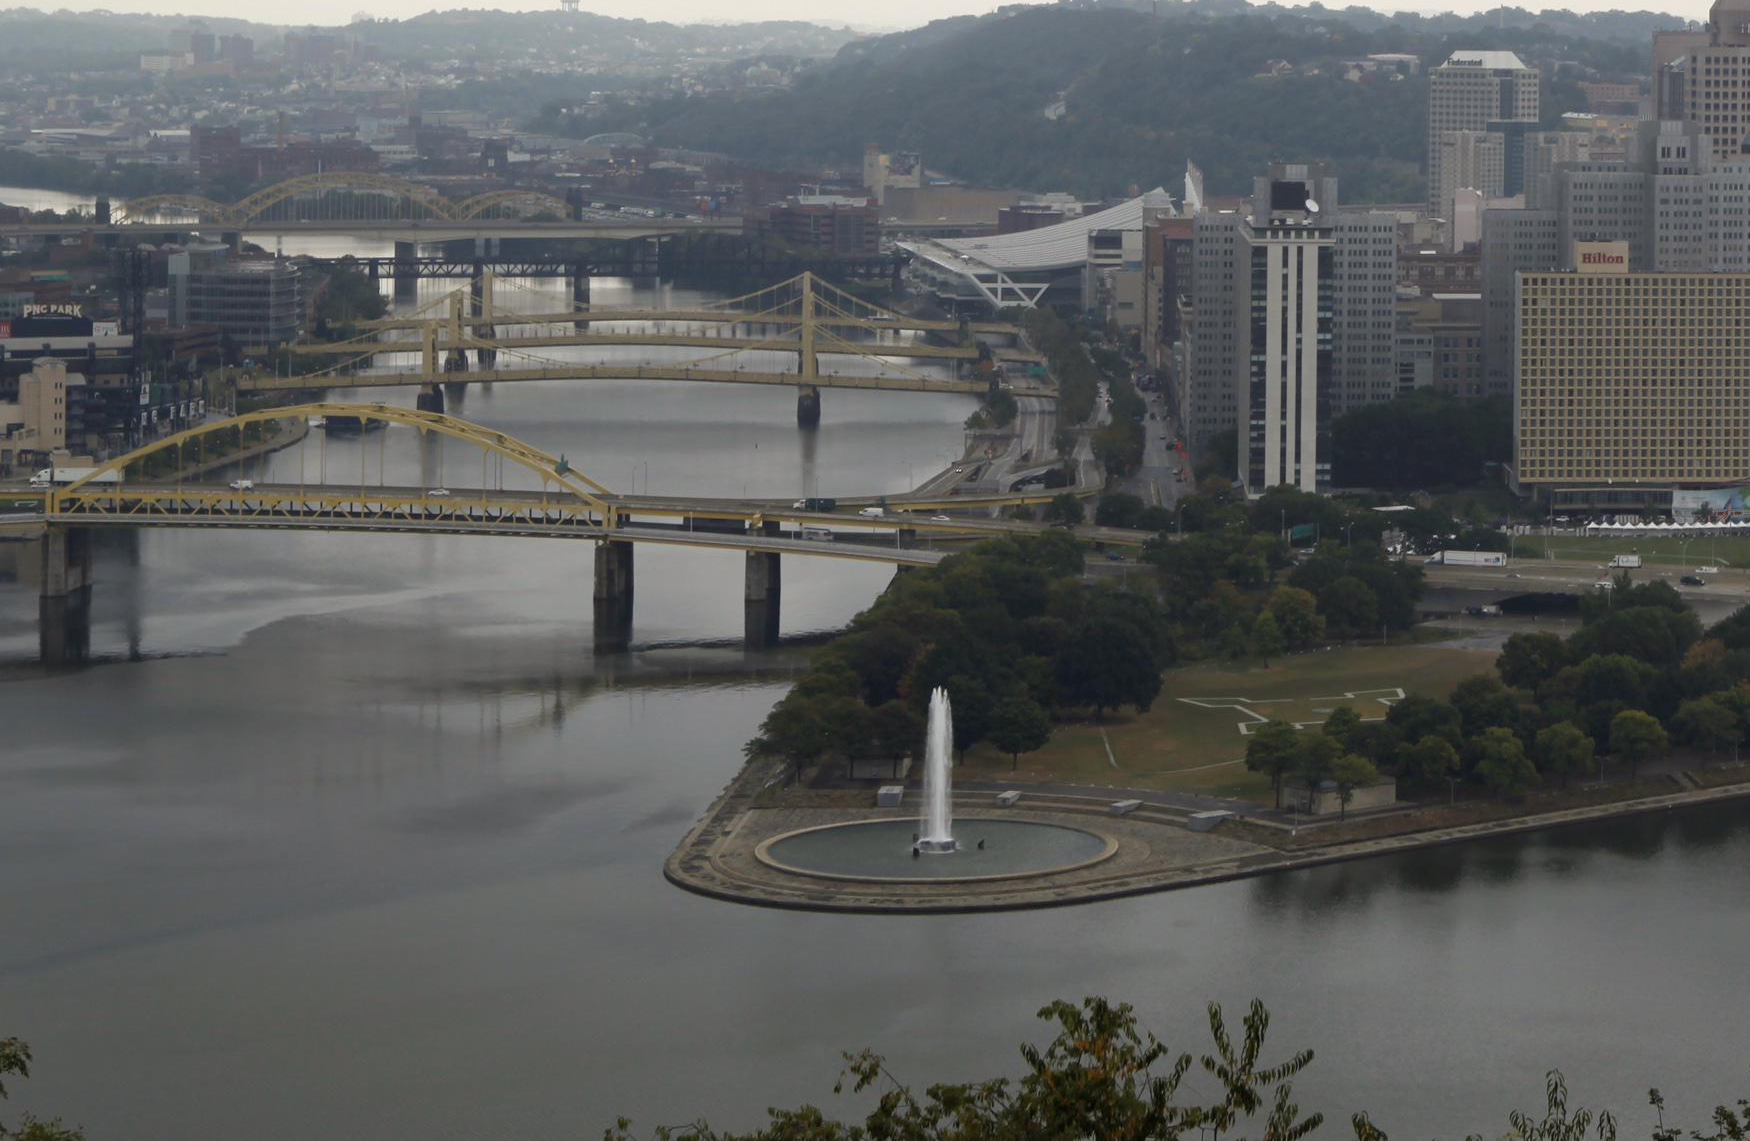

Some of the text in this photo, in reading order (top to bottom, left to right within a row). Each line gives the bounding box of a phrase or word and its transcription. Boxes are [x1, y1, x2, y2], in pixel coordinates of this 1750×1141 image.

[1582, 252, 1624, 264] Hilton
[24, 304, 82, 318] PNC PARK
